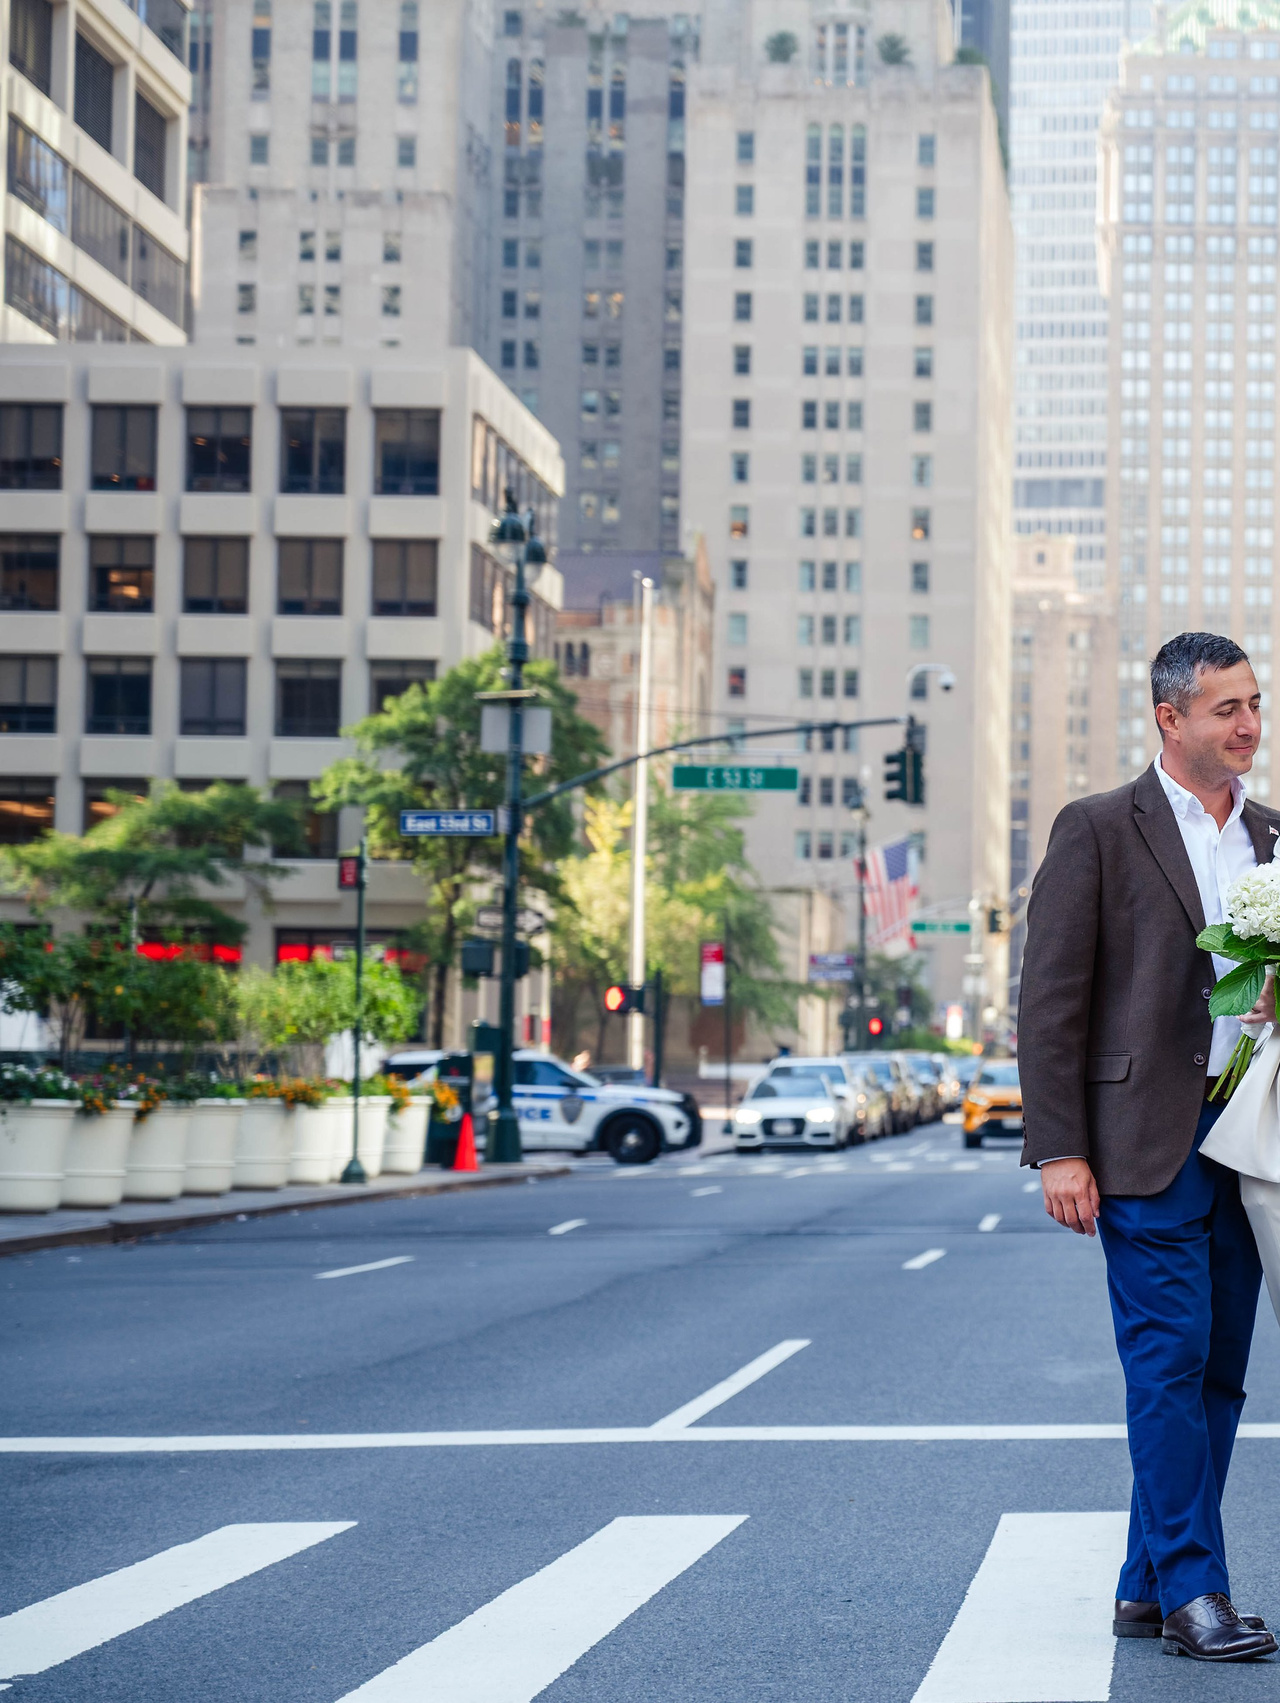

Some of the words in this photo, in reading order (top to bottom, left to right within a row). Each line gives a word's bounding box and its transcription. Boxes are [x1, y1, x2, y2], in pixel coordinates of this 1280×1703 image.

[707, 769, 716, 788] E
[722, 768, 741, 788] 53
[405, 815, 437, 832] East
[440, 815, 469, 832] 53rd
[472, 815, 489, 832] St
